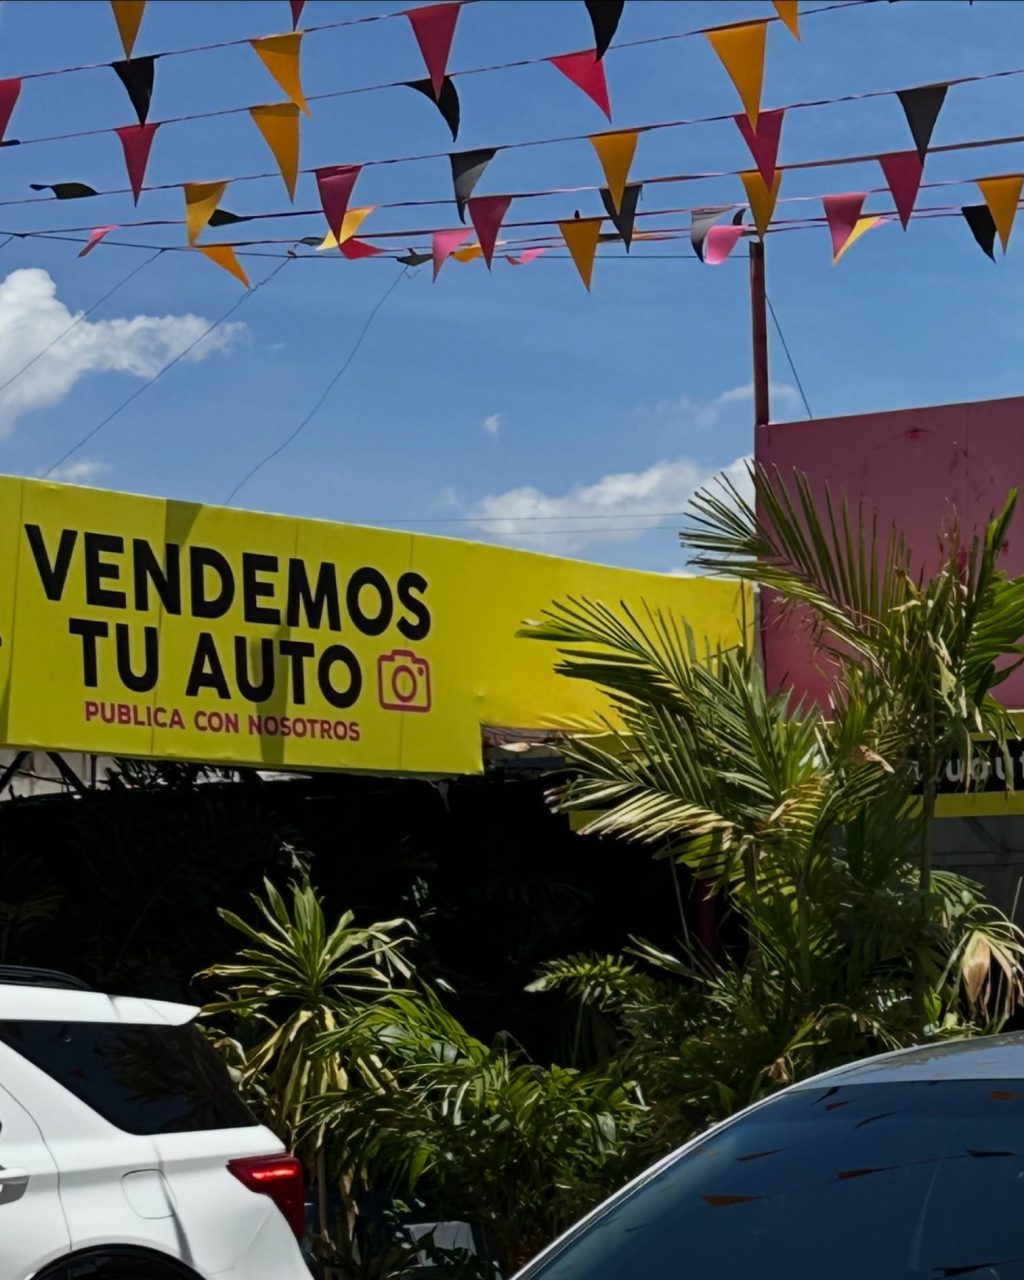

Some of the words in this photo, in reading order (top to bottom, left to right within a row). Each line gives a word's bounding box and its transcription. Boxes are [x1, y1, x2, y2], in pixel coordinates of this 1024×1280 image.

[24, 523, 432, 642] VENDEMOS
[69, 618, 160, 694] TU
[185, 630, 363, 710] AUTO
[85, 701, 185, 730] PUBLICA
[194, 709, 241, 735] CON
[249, 715, 361, 742] NOSOTROS
